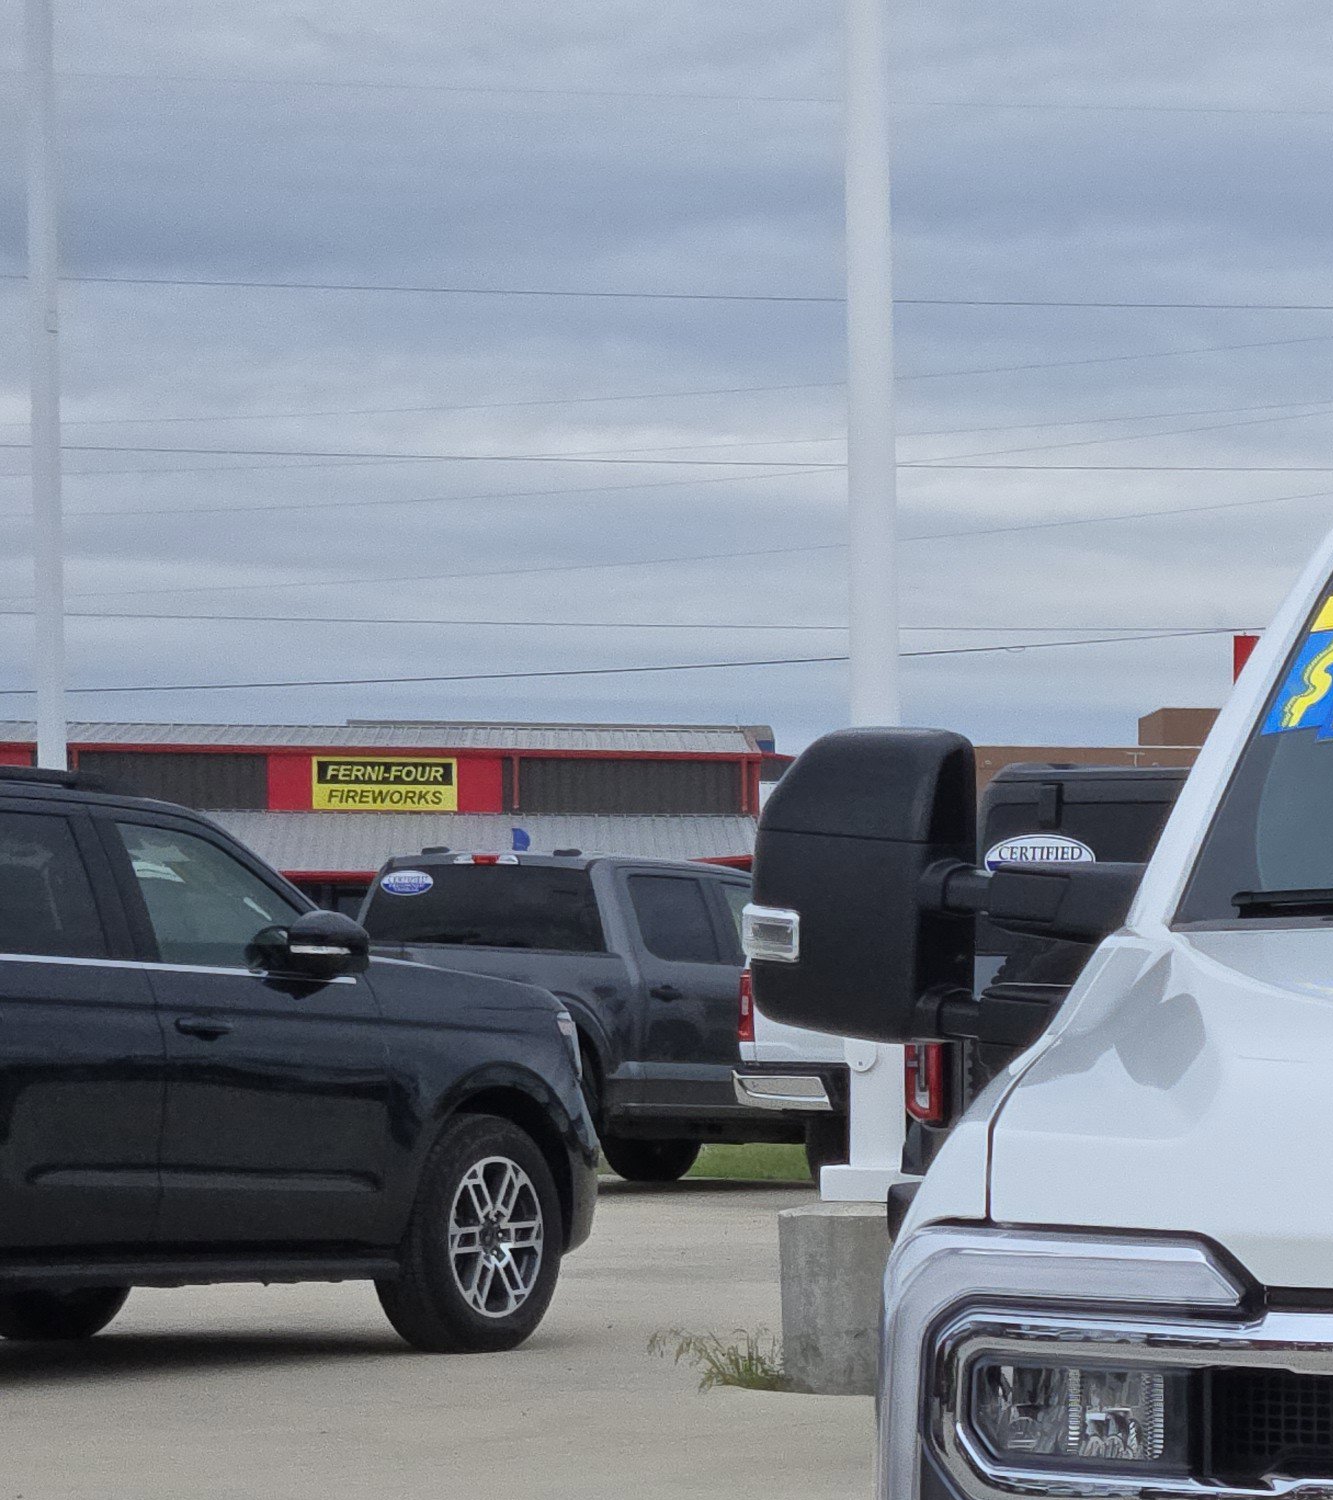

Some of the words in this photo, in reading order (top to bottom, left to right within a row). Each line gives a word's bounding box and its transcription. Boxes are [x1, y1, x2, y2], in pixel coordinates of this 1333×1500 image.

[325, 764, 444, 782] FERNI-FOUR
[326, 788, 443, 805] FIREWORKS
[998, 845, 1083, 861] CERTIFIED
